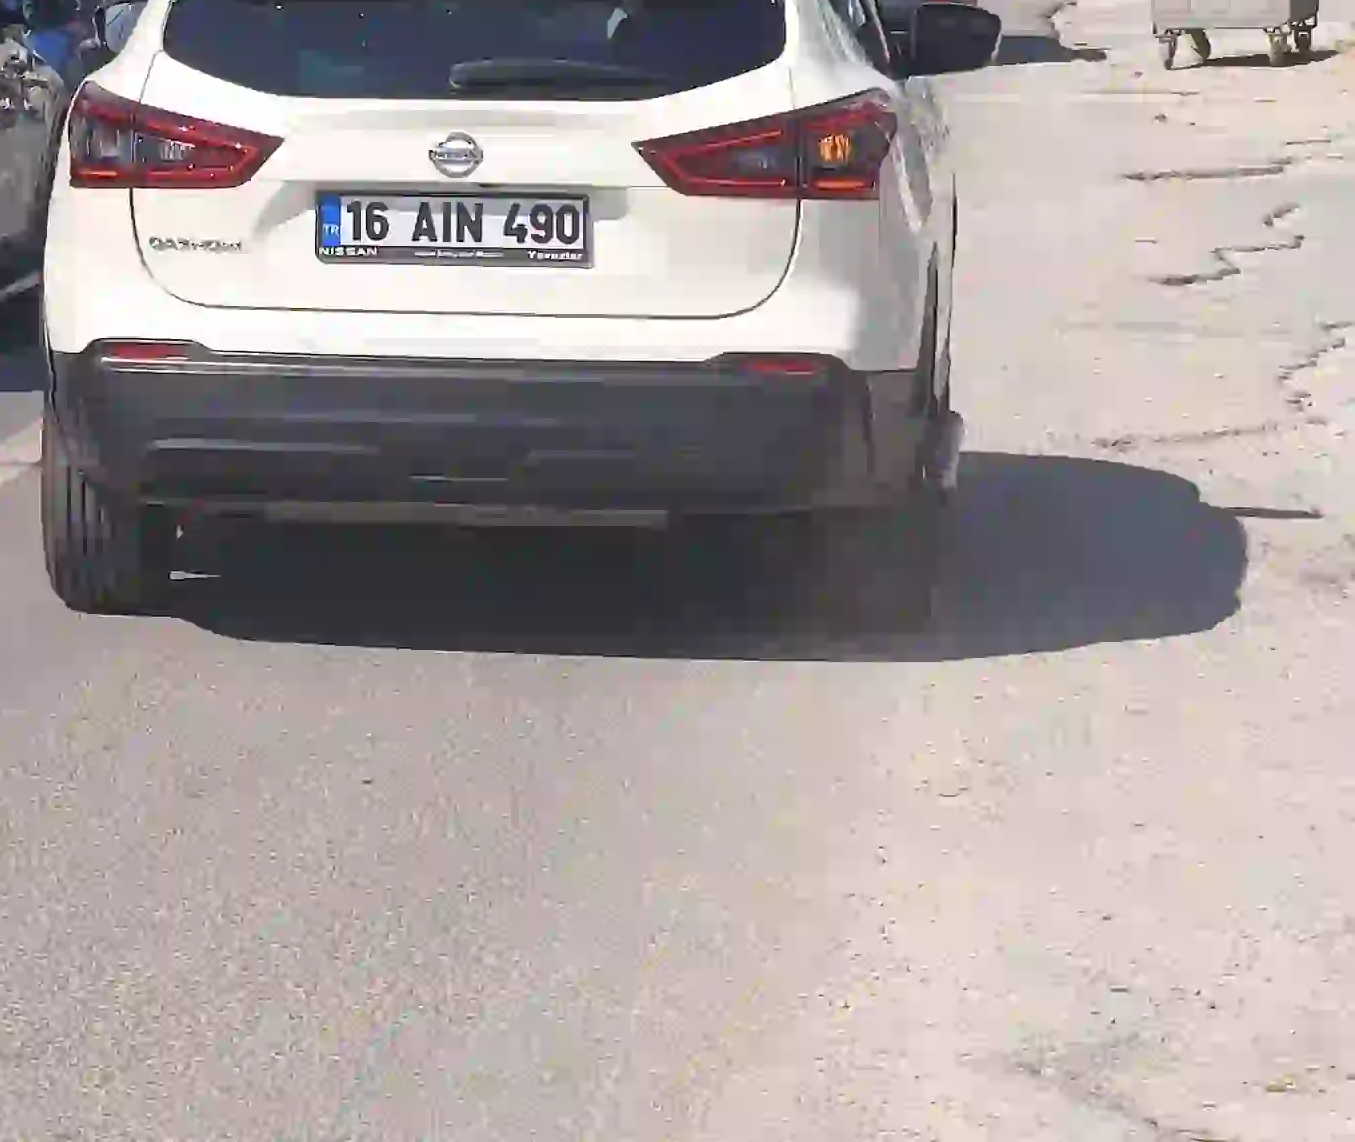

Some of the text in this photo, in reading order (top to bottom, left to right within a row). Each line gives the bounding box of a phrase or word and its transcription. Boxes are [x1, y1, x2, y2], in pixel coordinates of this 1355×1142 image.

[346, 200, 390, 242] 16
[411, 201, 483, 243] AIN
[503, 202, 580, 245] 490
